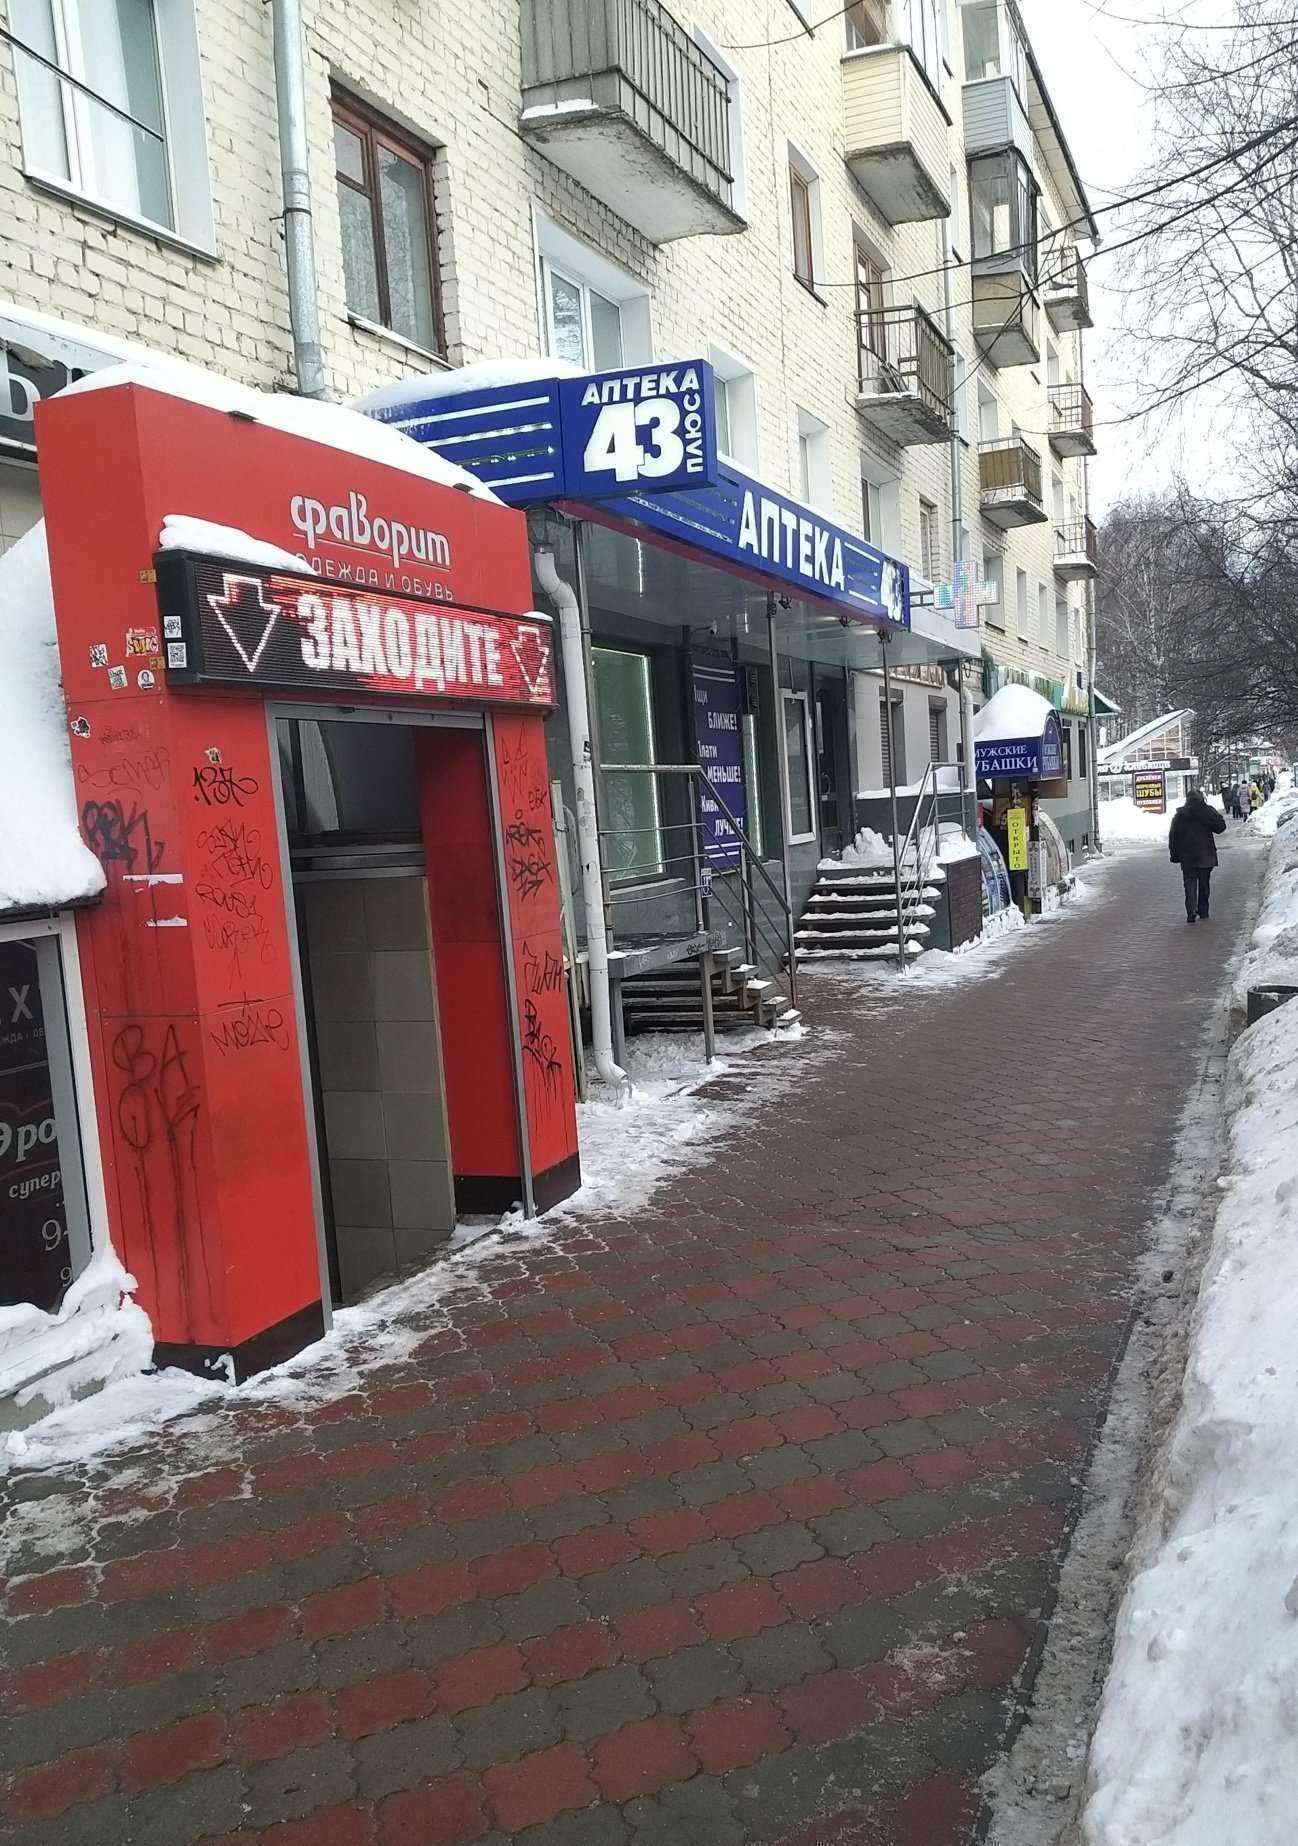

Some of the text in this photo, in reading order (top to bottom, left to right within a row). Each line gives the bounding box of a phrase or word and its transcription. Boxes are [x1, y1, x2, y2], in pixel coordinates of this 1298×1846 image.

[581, 368, 700, 406] АПТЕКА
[584, 398, 684, 482] 43
[683, 392, 703, 473] ПЛЮС
[738, 489, 845, 591] АПТЕКА
[385, 573, 395, 586] И
[401, 575, 454, 601] ОБУВЬ
[297, 593, 504, 692] ЗАХОДИТЕ
[707, 711, 738, 732] БЛИЖЕ!
[707, 765, 742, 783] МЕНЬШЕ!
[1136, 788, 1162, 798] ШУБЫ
[1011, 821, 1021, 868] ОТКРЫТО
